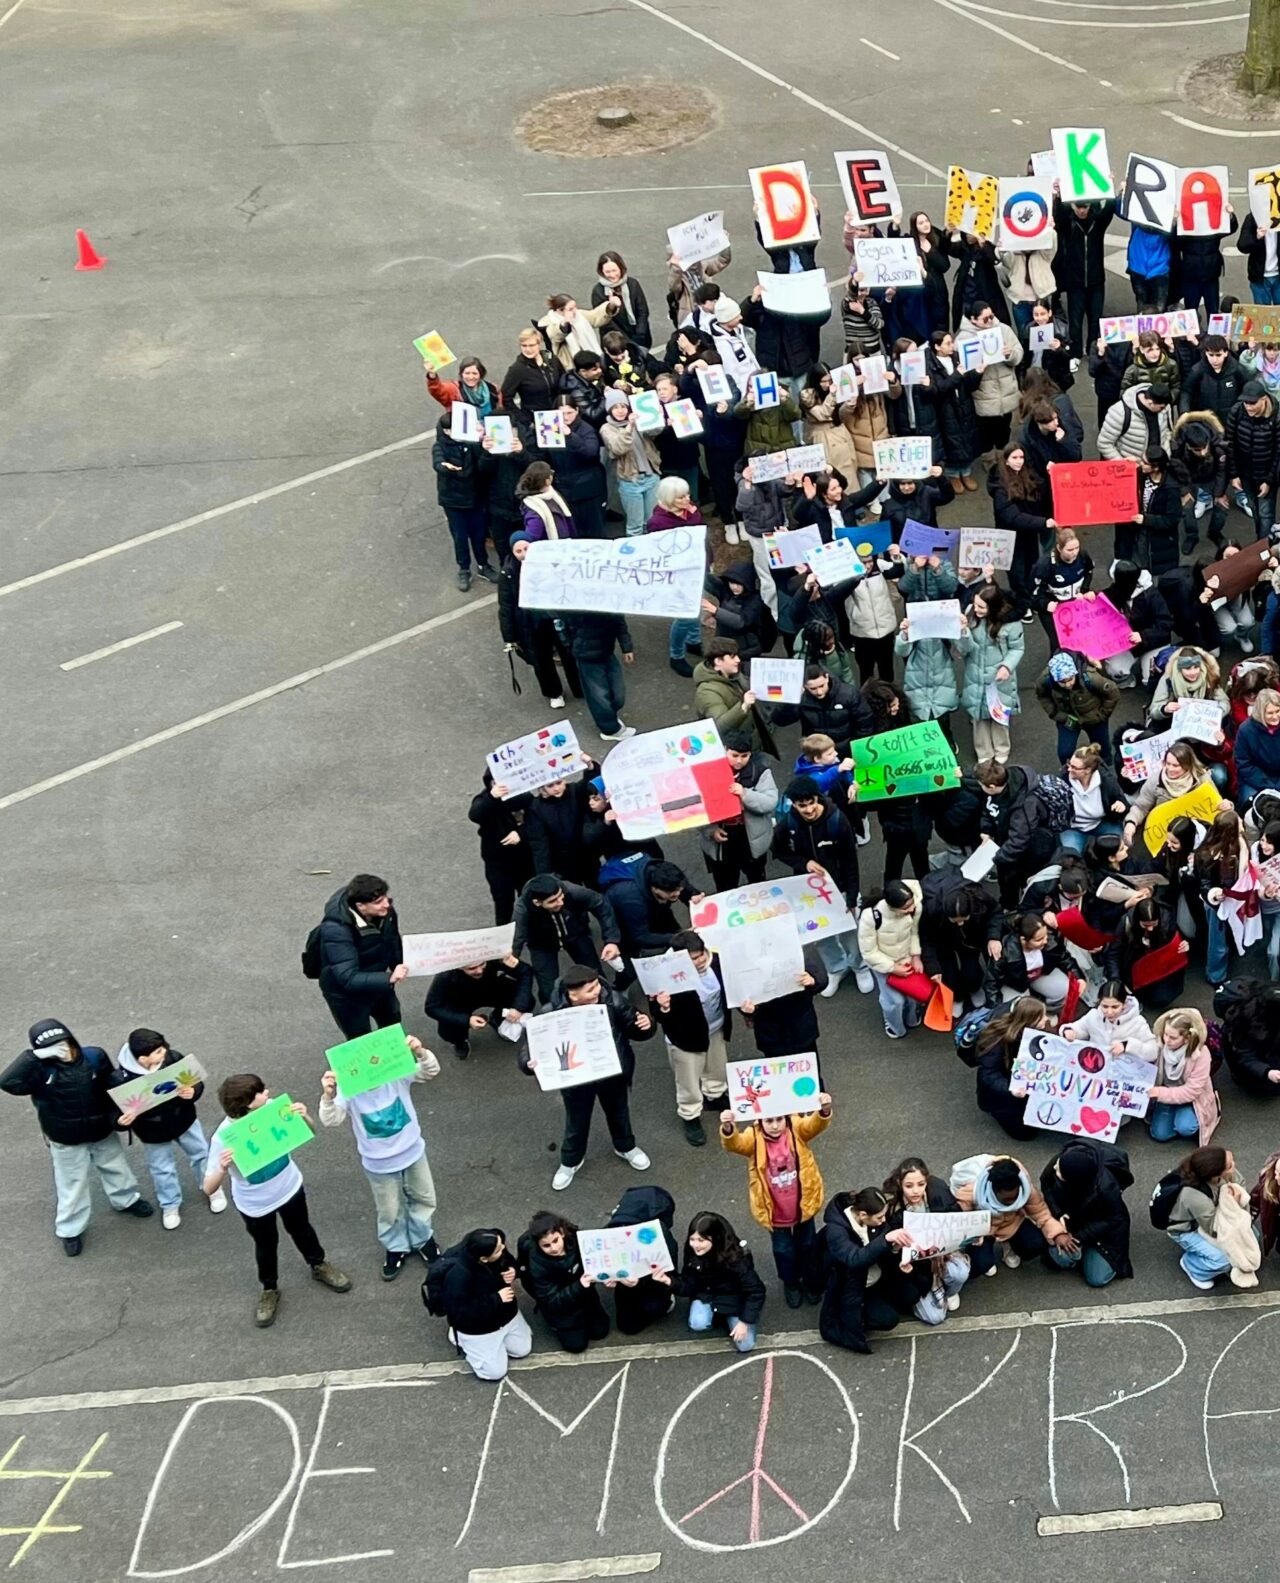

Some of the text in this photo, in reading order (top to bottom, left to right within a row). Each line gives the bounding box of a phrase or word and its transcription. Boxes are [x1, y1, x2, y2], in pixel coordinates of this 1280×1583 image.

[1066, 132, 1110, 196] K
[759, 168, 808, 241] D
[847, 158, 893, 220] E
[946, 167, 999, 240] M
[1123, 157, 1167, 227] R
[1180, 170, 1223, 231] A
[1003, 191, 1049, 238] O
[857, 240, 894, 260] Gegen
[964, 340, 980, 371] F
[703, 372, 721, 395] E
[755, 373, 778, 406] H
[636, 393, 660, 427] S
[736, 1059, 811, 1078] WELTFRIED
[1025, 1081, 1058, 1097] HASS
[1060, 1069, 1105, 1102] UND
[907, 1213, 990, 1231] ZUSAMMEN
